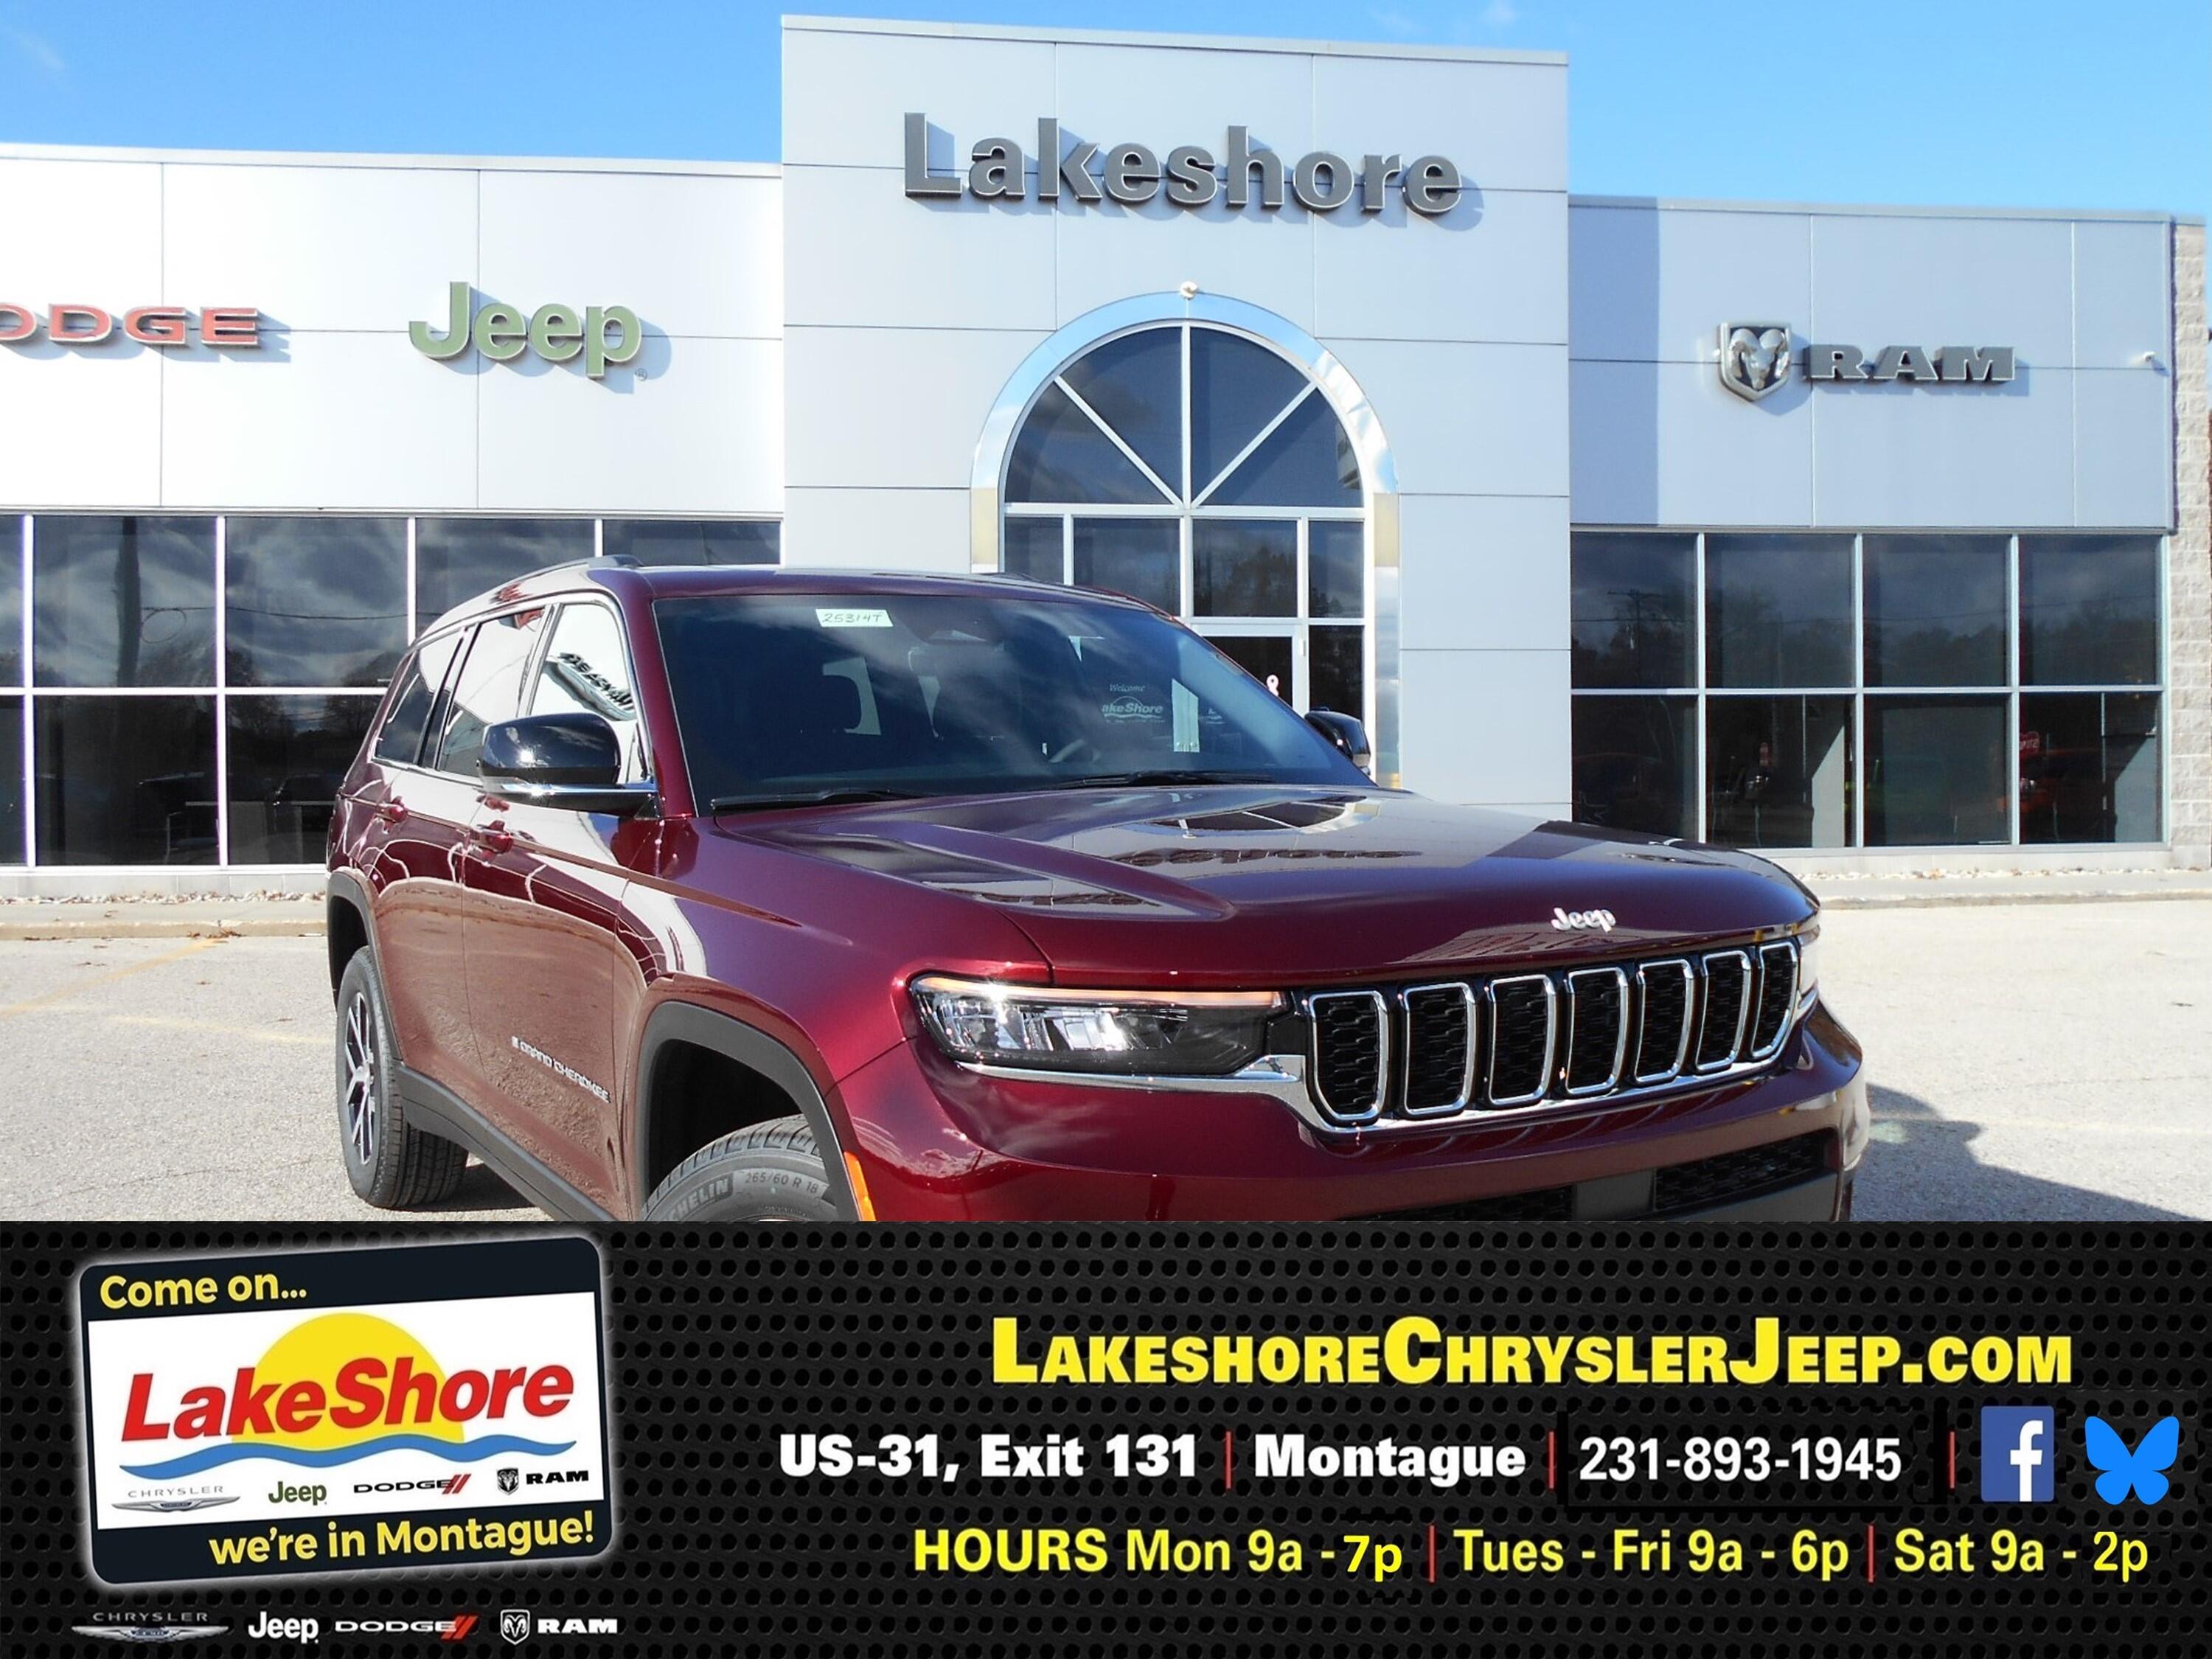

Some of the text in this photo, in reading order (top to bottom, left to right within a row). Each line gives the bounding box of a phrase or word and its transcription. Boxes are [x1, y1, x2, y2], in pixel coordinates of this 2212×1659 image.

[904, 112, 1463, 214] Lakeshore
[408, 281, 642, 378] Jeep
[1803, 344, 2016, 383] RAM
[1551, 907, 1616, 932] Jeep
[664, 1178, 729, 1221] CHELIN
[745, 1171, 819, 1193] 265/60 R 18
